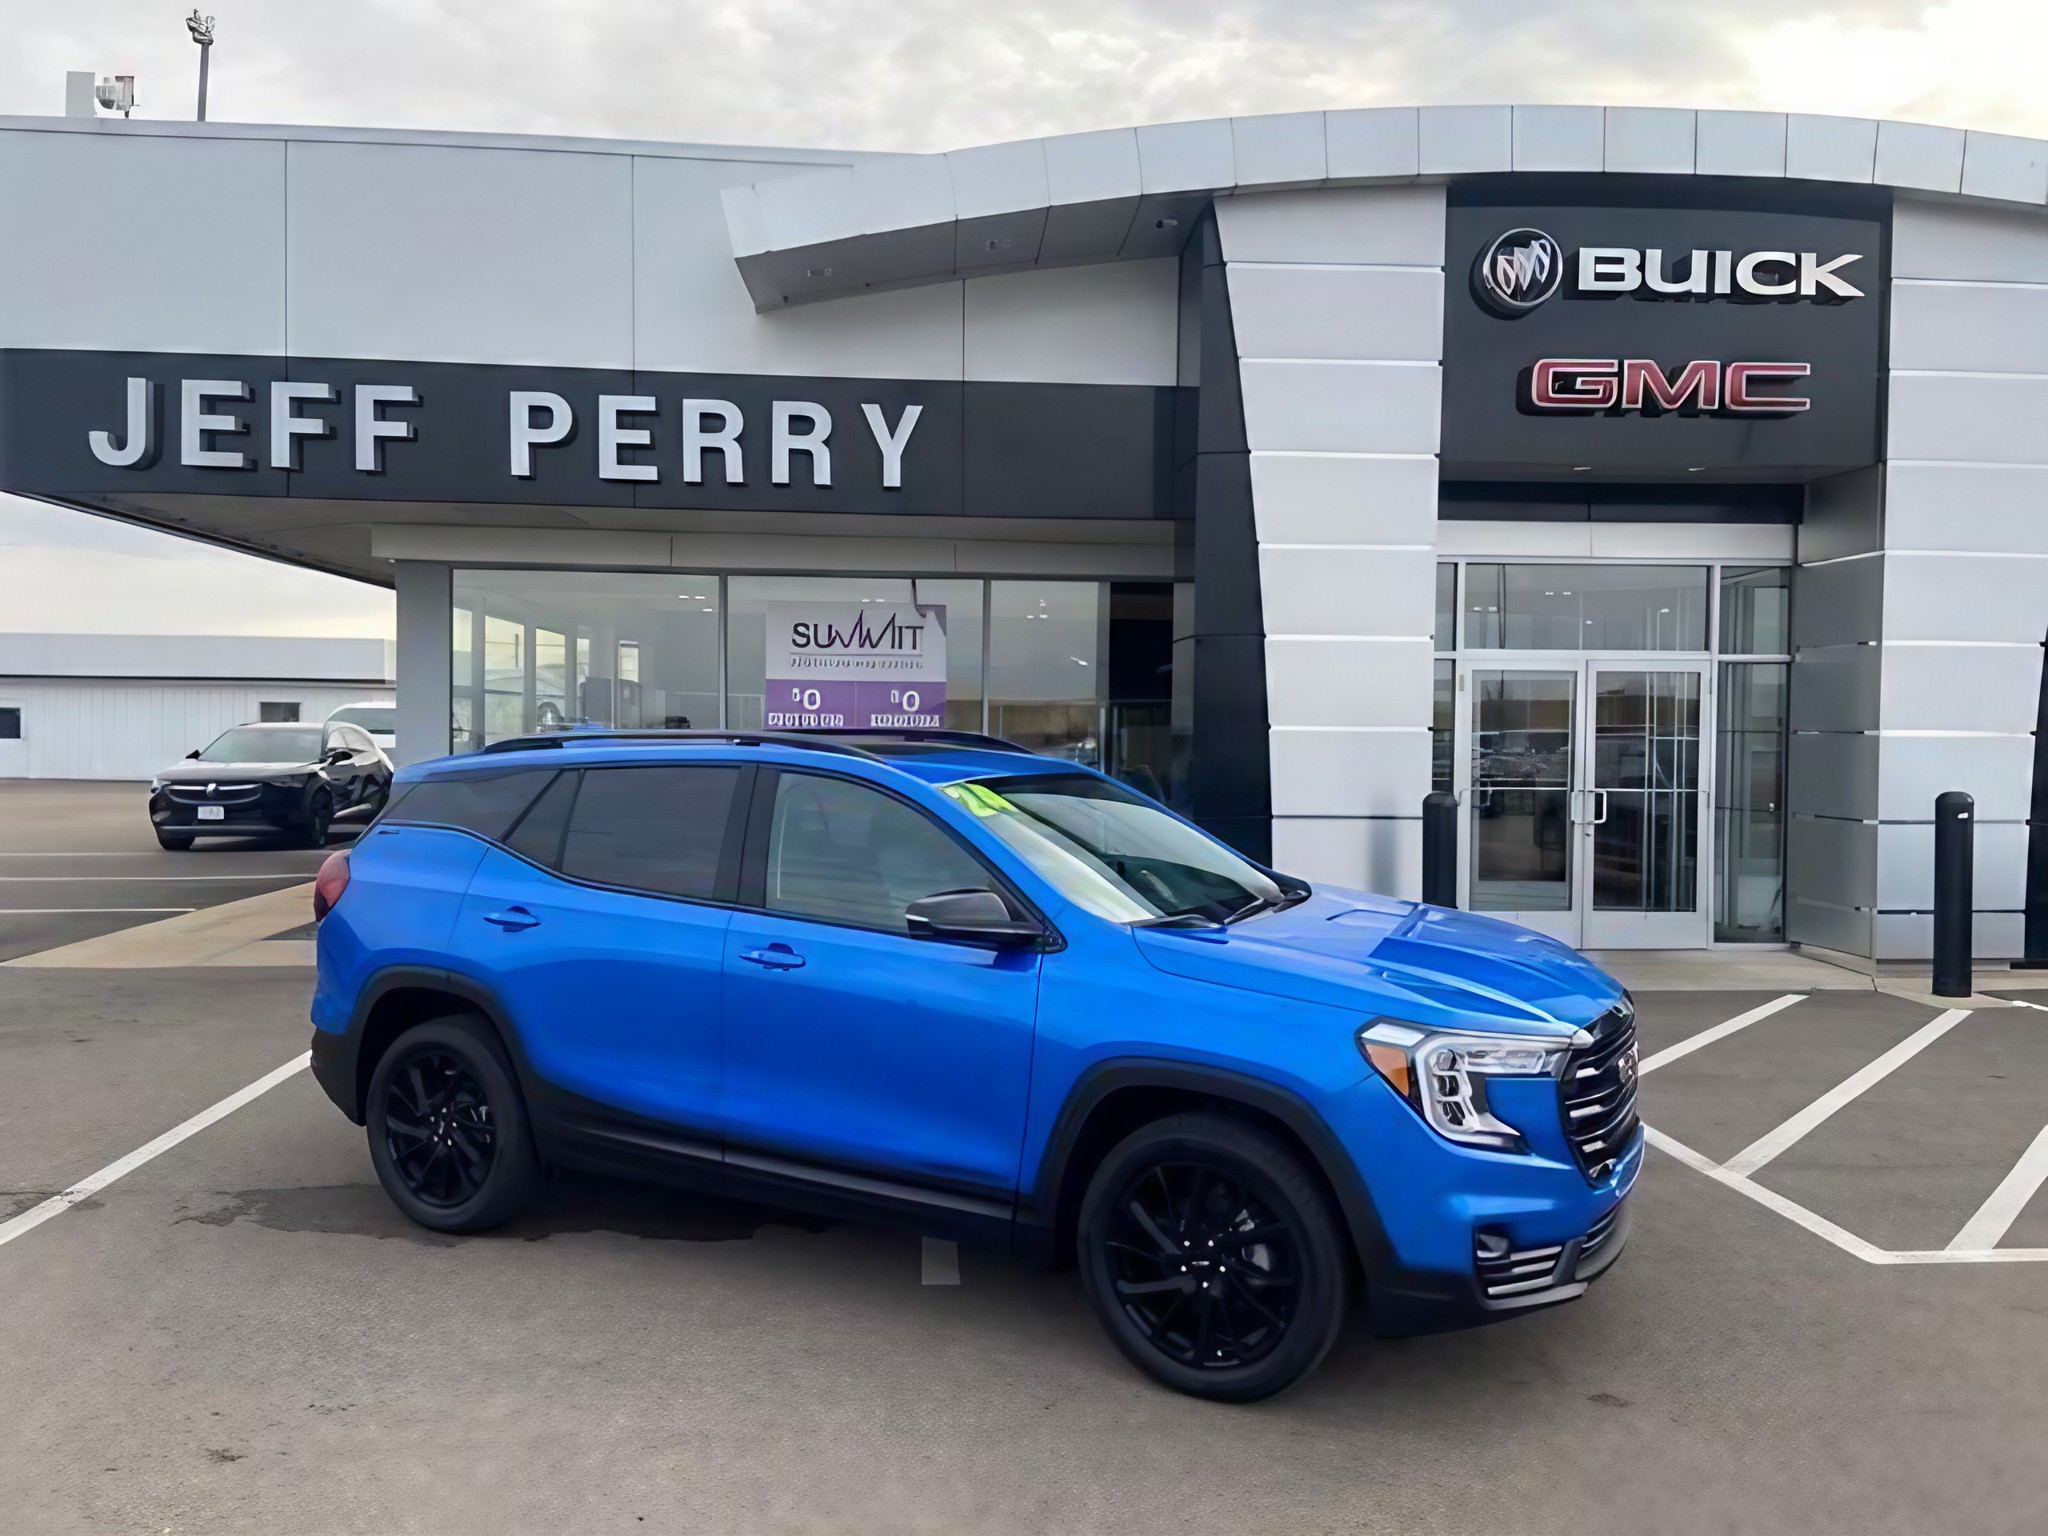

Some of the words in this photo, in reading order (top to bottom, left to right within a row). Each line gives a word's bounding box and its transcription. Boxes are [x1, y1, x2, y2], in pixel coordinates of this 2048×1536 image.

[1578, 247, 1865, 297] BUICK
[1531, 358, 1811, 411] GMC
[88, 376, 418, 472] JEFF
[510, 391, 924, 488] PERRY
